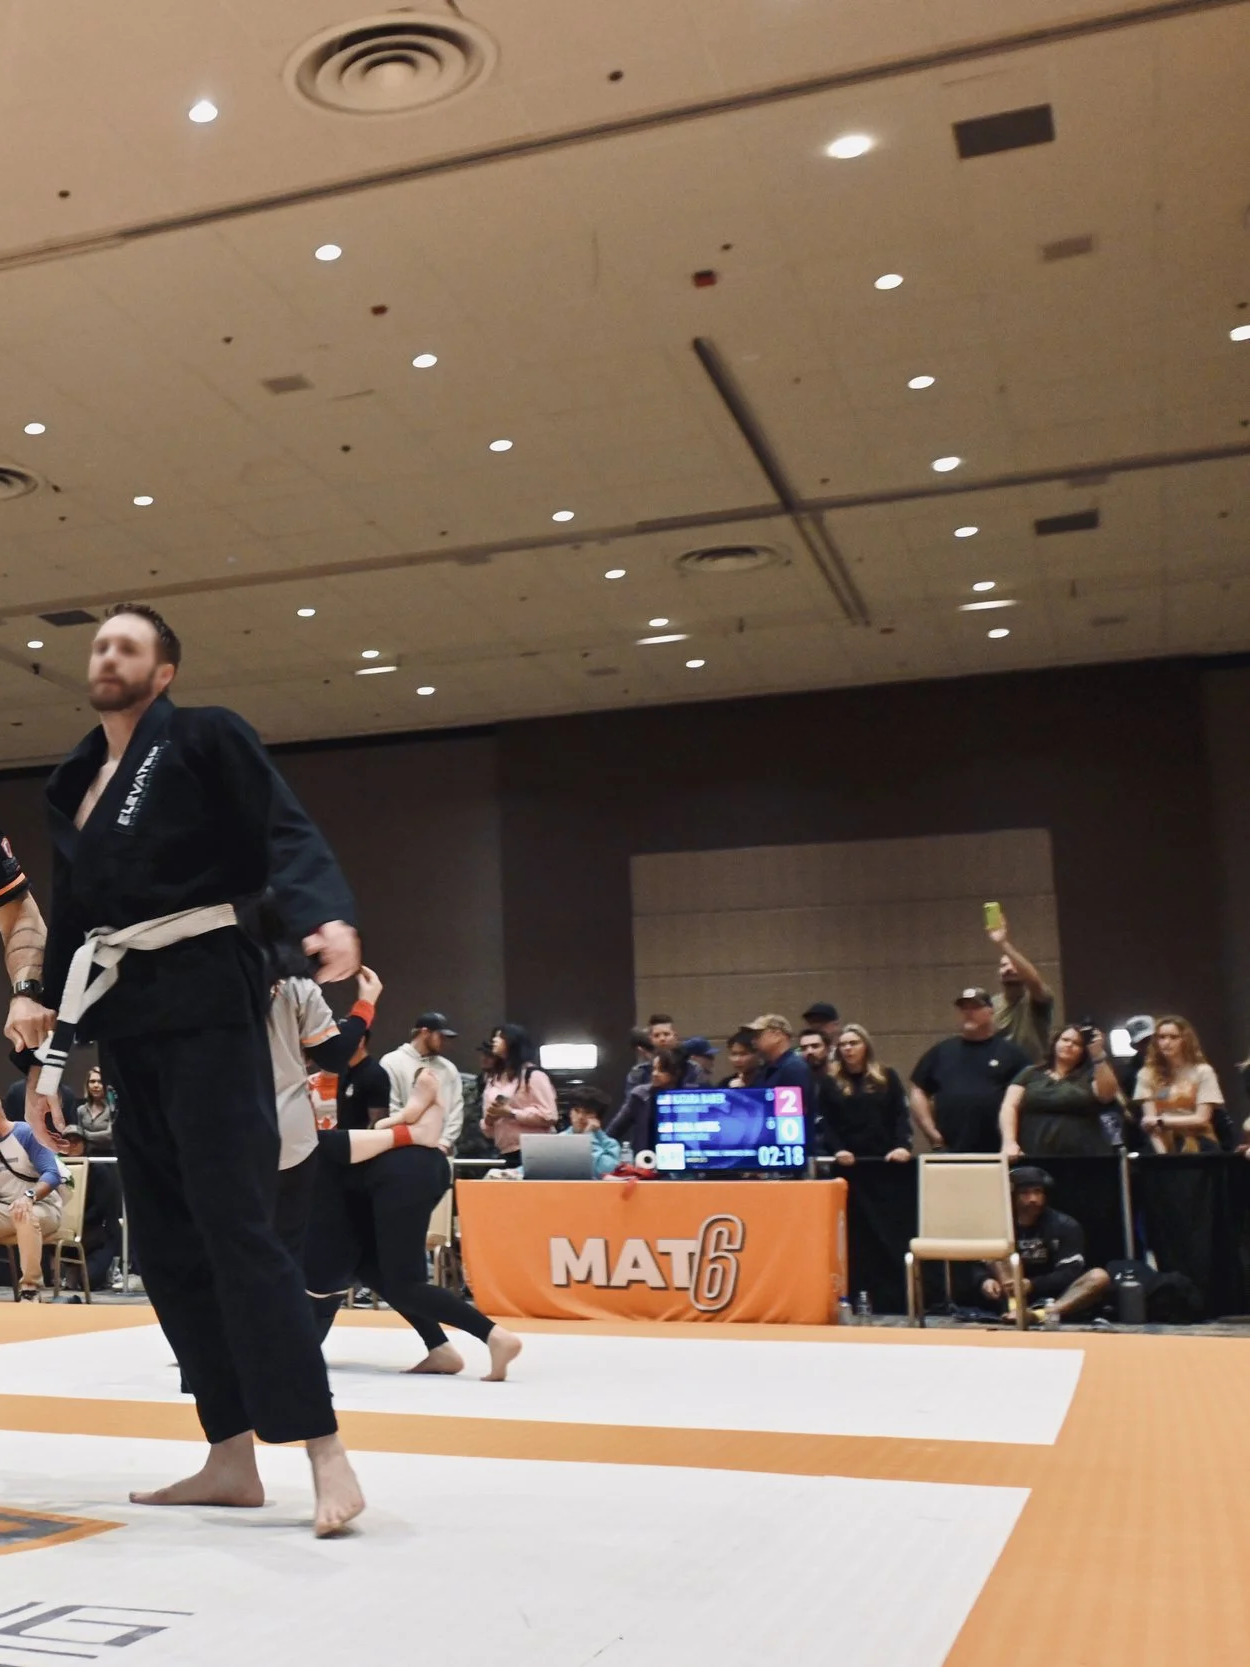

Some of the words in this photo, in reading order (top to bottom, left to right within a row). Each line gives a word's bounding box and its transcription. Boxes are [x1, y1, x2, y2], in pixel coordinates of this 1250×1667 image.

[779, 1089, 799, 1113] 2
[781, 1118, 799, 1142] 0
[758, 1145, 805, 1167] 02:18
